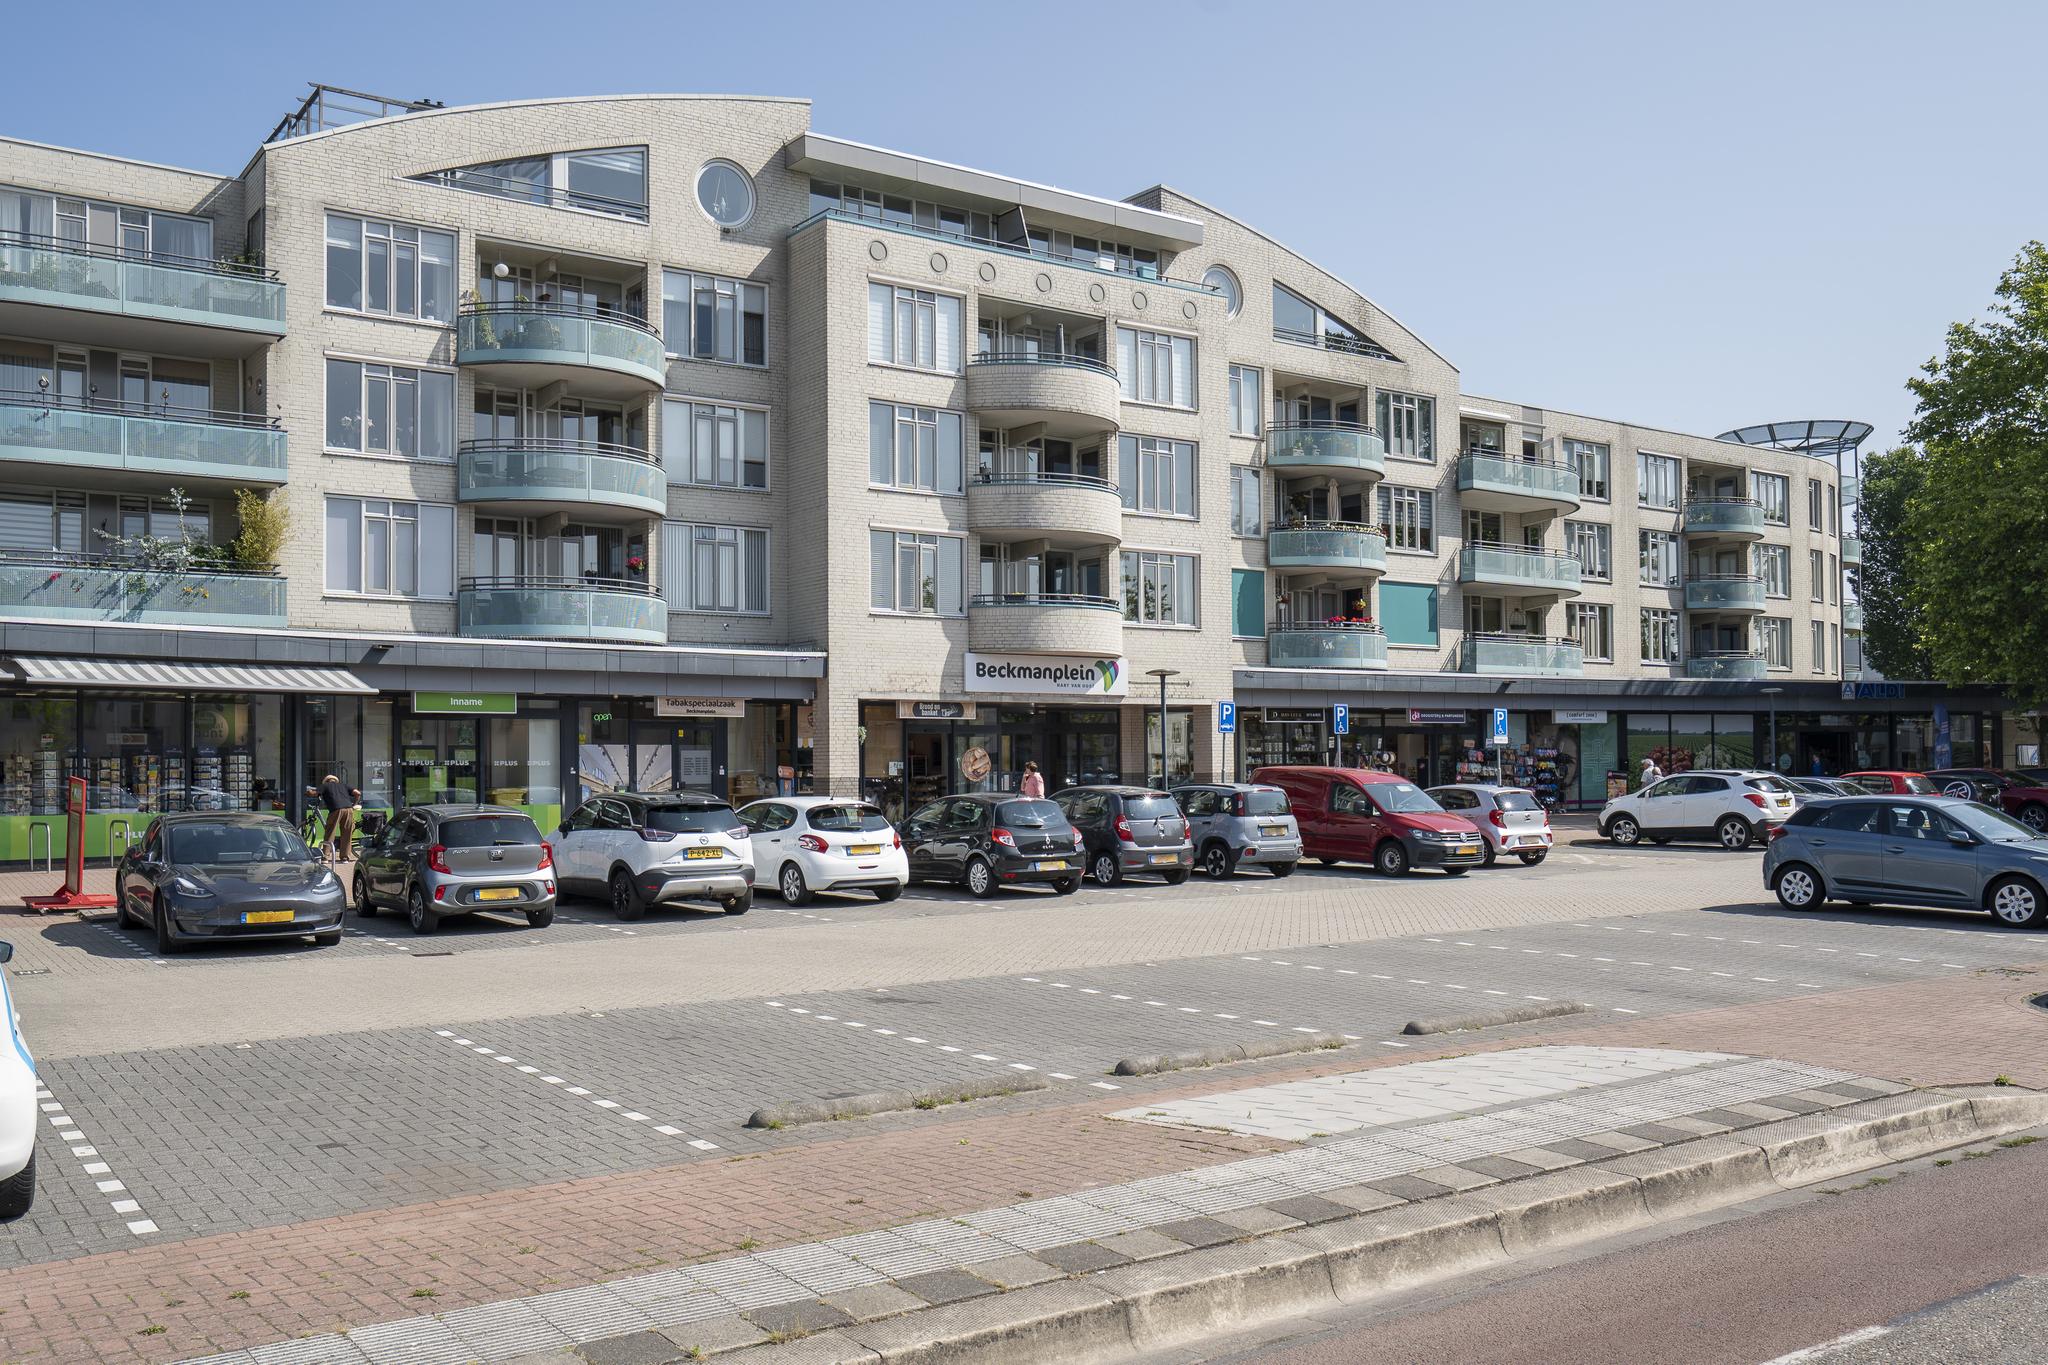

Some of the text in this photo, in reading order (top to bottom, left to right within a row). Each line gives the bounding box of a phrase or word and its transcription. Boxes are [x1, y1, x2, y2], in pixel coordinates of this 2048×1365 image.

[975, 662, 1095, 683] Beckmanplein
[1857, 682, 1905, 698] ALDI
[450, 697, 483, 706] Inname
[665, 699, 736, 709] Tabakspeciaalzaak
[593, 713, 613, 722] open
[1223, 704, 1232, 720] P
[1337, 707, 1346, 722] P
[1497, 711, 1504, 725] P
